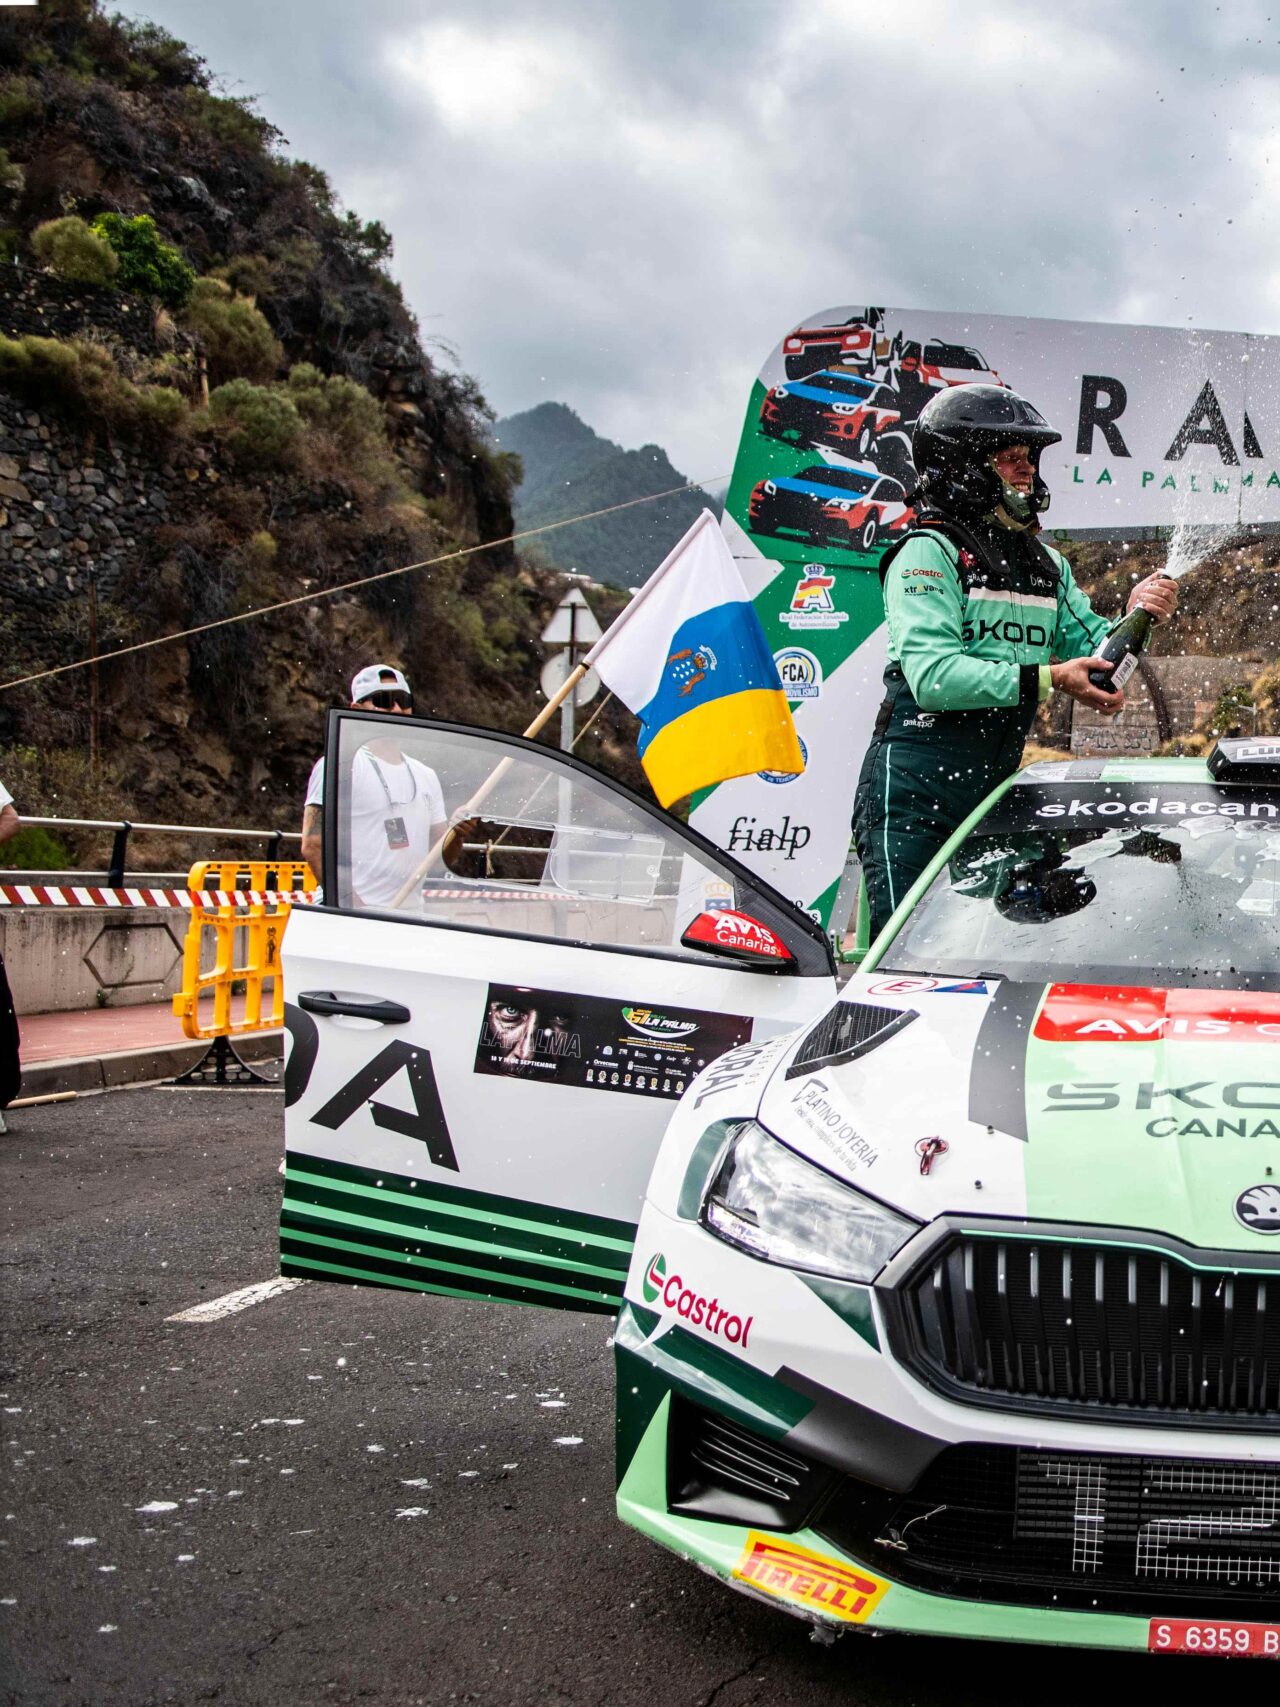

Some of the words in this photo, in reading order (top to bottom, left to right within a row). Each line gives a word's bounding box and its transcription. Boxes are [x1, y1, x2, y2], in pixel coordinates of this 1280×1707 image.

[1073, 465, 1113, 486] LA
[782, 663, 804, 681] FCA
[725, 816, 811, 860] fialp
[715, 915, 774, 944] AVIS
[717, 931, 778, 955] Canarias
[1076, 1017, 1232, 1038] AVIS
[520, 1059, 557, 1069] SEPTIEMBRE
[805, 1089, 840, 1127] PLATINO
[664, 1275, 753, 1348] Castrol
[740, 1541, 877, 1615] PIRELLI
[1156, 1625, 1171, 1647] S
[1186, 1626, 1250, 1651] 6359
